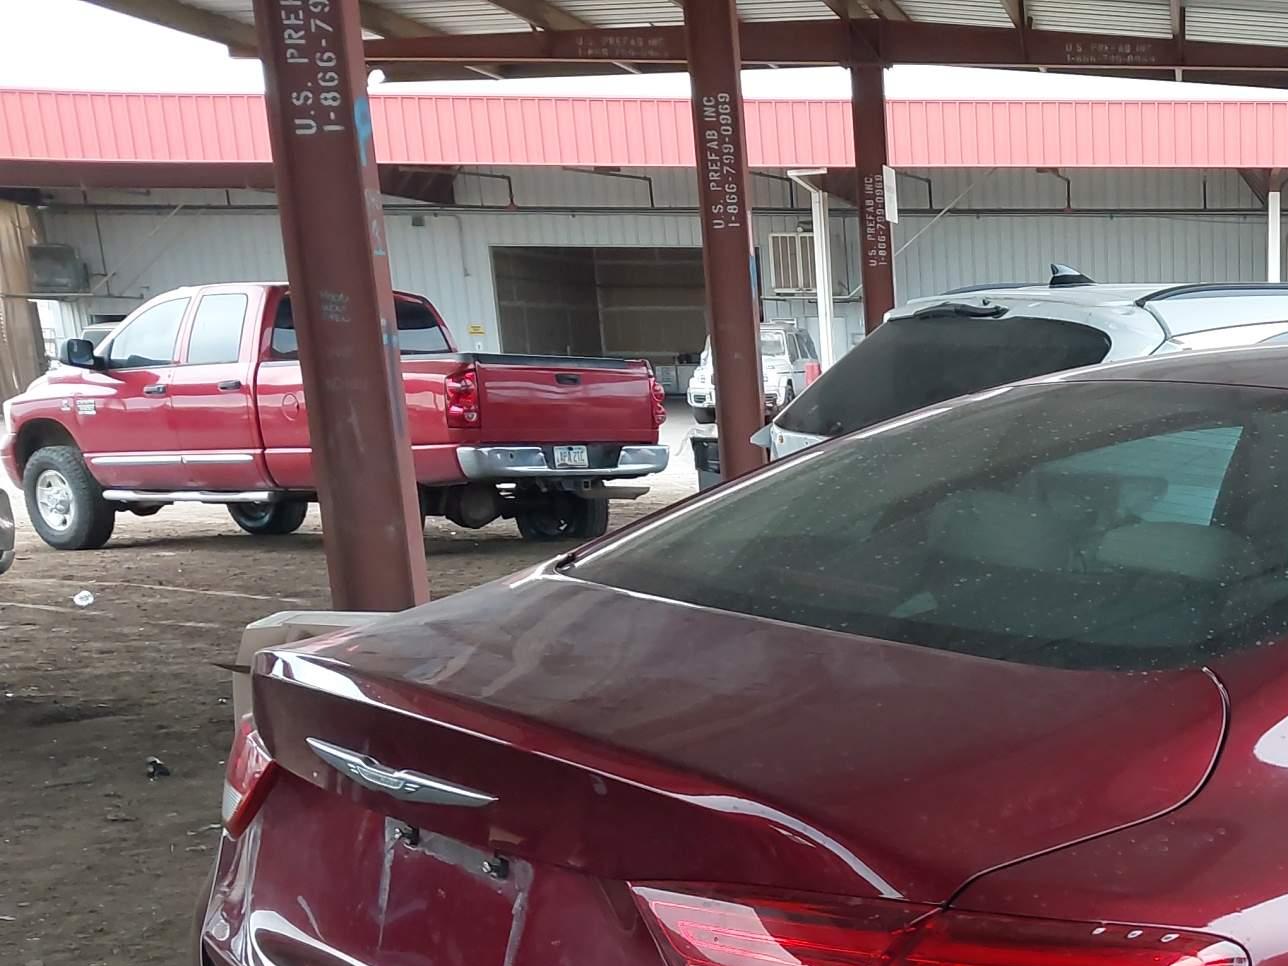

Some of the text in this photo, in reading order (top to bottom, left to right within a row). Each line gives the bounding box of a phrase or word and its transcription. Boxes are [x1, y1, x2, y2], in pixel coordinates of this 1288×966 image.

[292, 82, 318, 135] U.S.
[703, 96, 717, 121] INC
[705, 129, 723, 192] PREFAB
[718, 93, 740, 227] 1-866-799-0969
